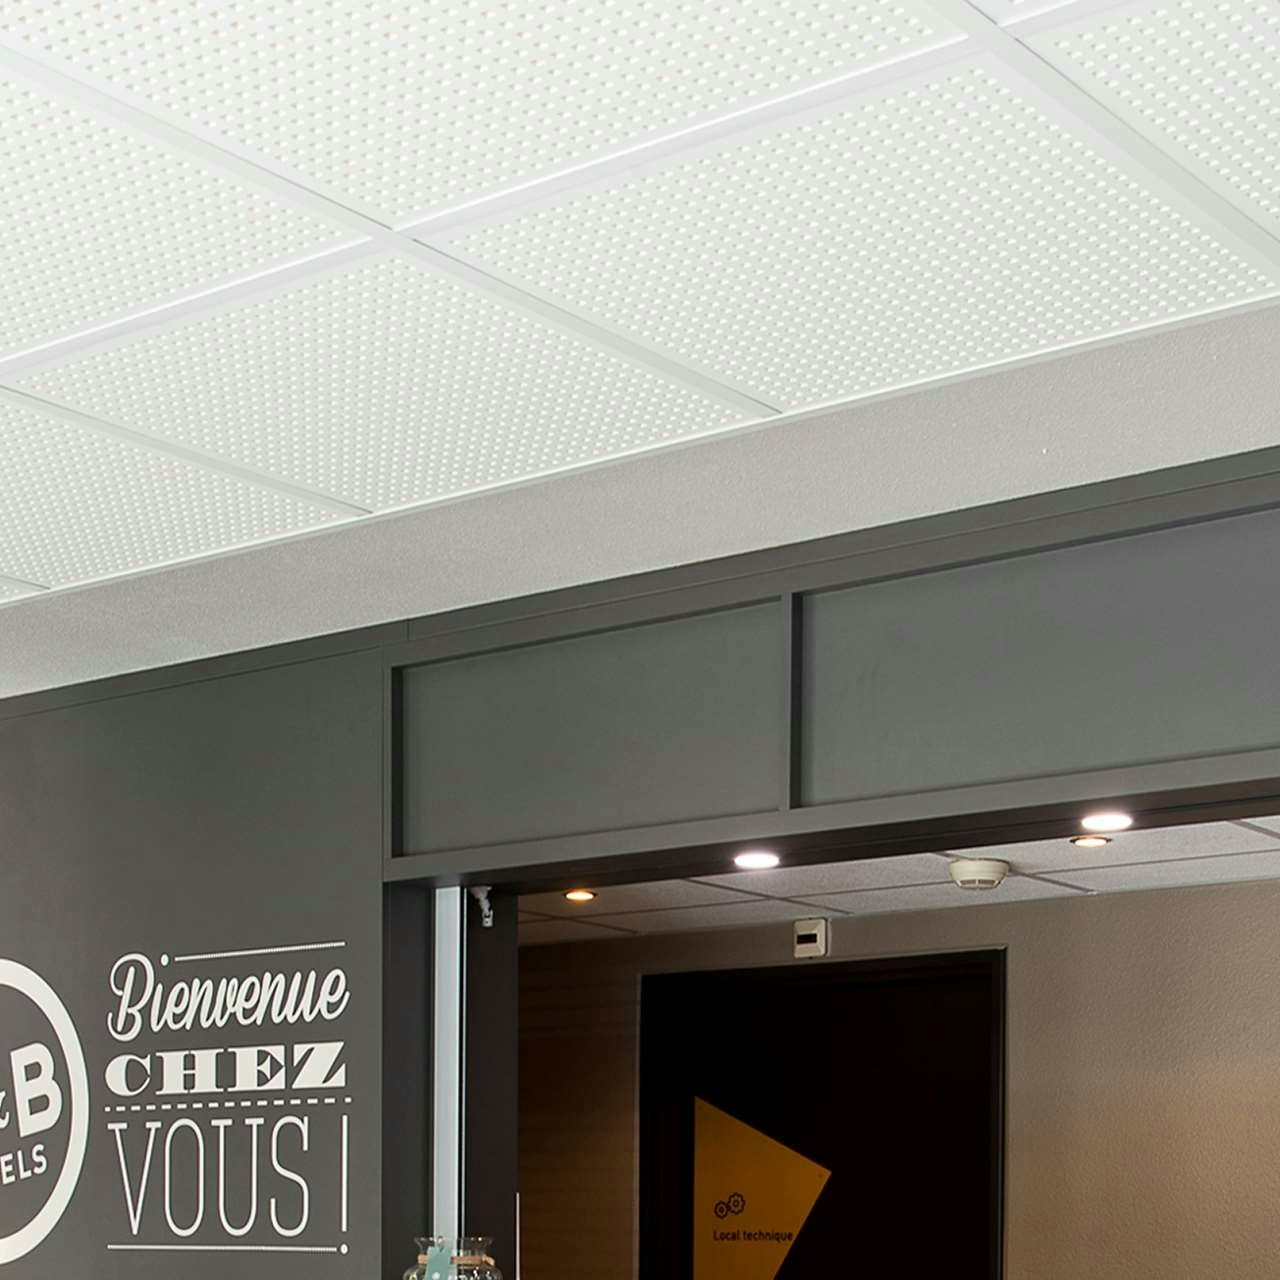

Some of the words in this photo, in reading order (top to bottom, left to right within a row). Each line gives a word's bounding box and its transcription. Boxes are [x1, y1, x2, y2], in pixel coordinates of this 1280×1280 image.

[107, 952, 350, 1041] Bienvenue
[105, 1041, 346, 1097] CHEZ
[107, 1115, 310, 1237] VOUS
[713, 1229, 740, 1242] Local
[743, 1229, 793, 1244] technique
